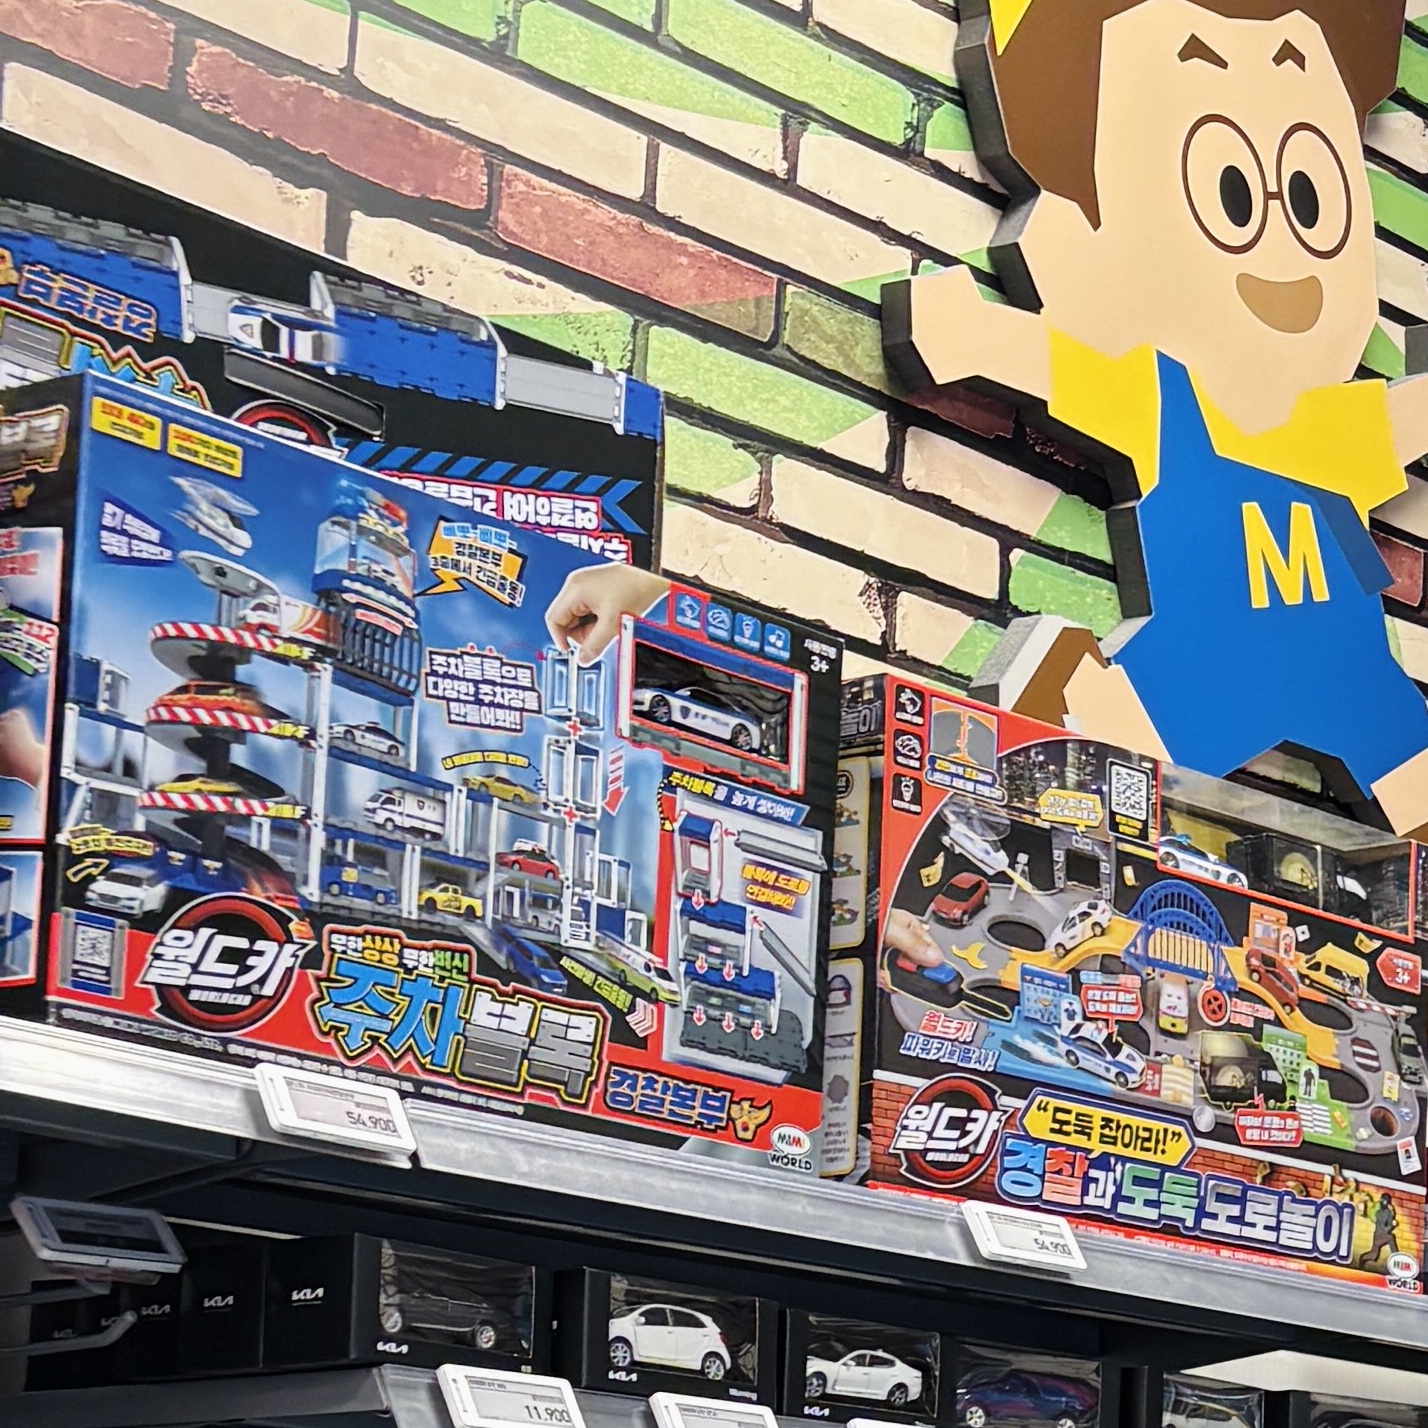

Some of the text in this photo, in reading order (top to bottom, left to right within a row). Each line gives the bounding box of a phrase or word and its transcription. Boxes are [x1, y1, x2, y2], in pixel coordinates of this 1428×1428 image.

[1242, 499, 1330, 608] M
[142, 925, 300, 997] 월드카
[316, 959, 596, 1099] 주차블록
[346, 1110, 396, 1135] 54.900
[607, 1069, 730, 1129] 경찰본부
[888, 1103, 1007, 1157] 월드카
[769, 1152, 812, 1172] WORLD
[1001, 1138, 1353, 1264] 경찰과 도둑 도로놀이
[523, 1403, 572, 1425] 11.900
